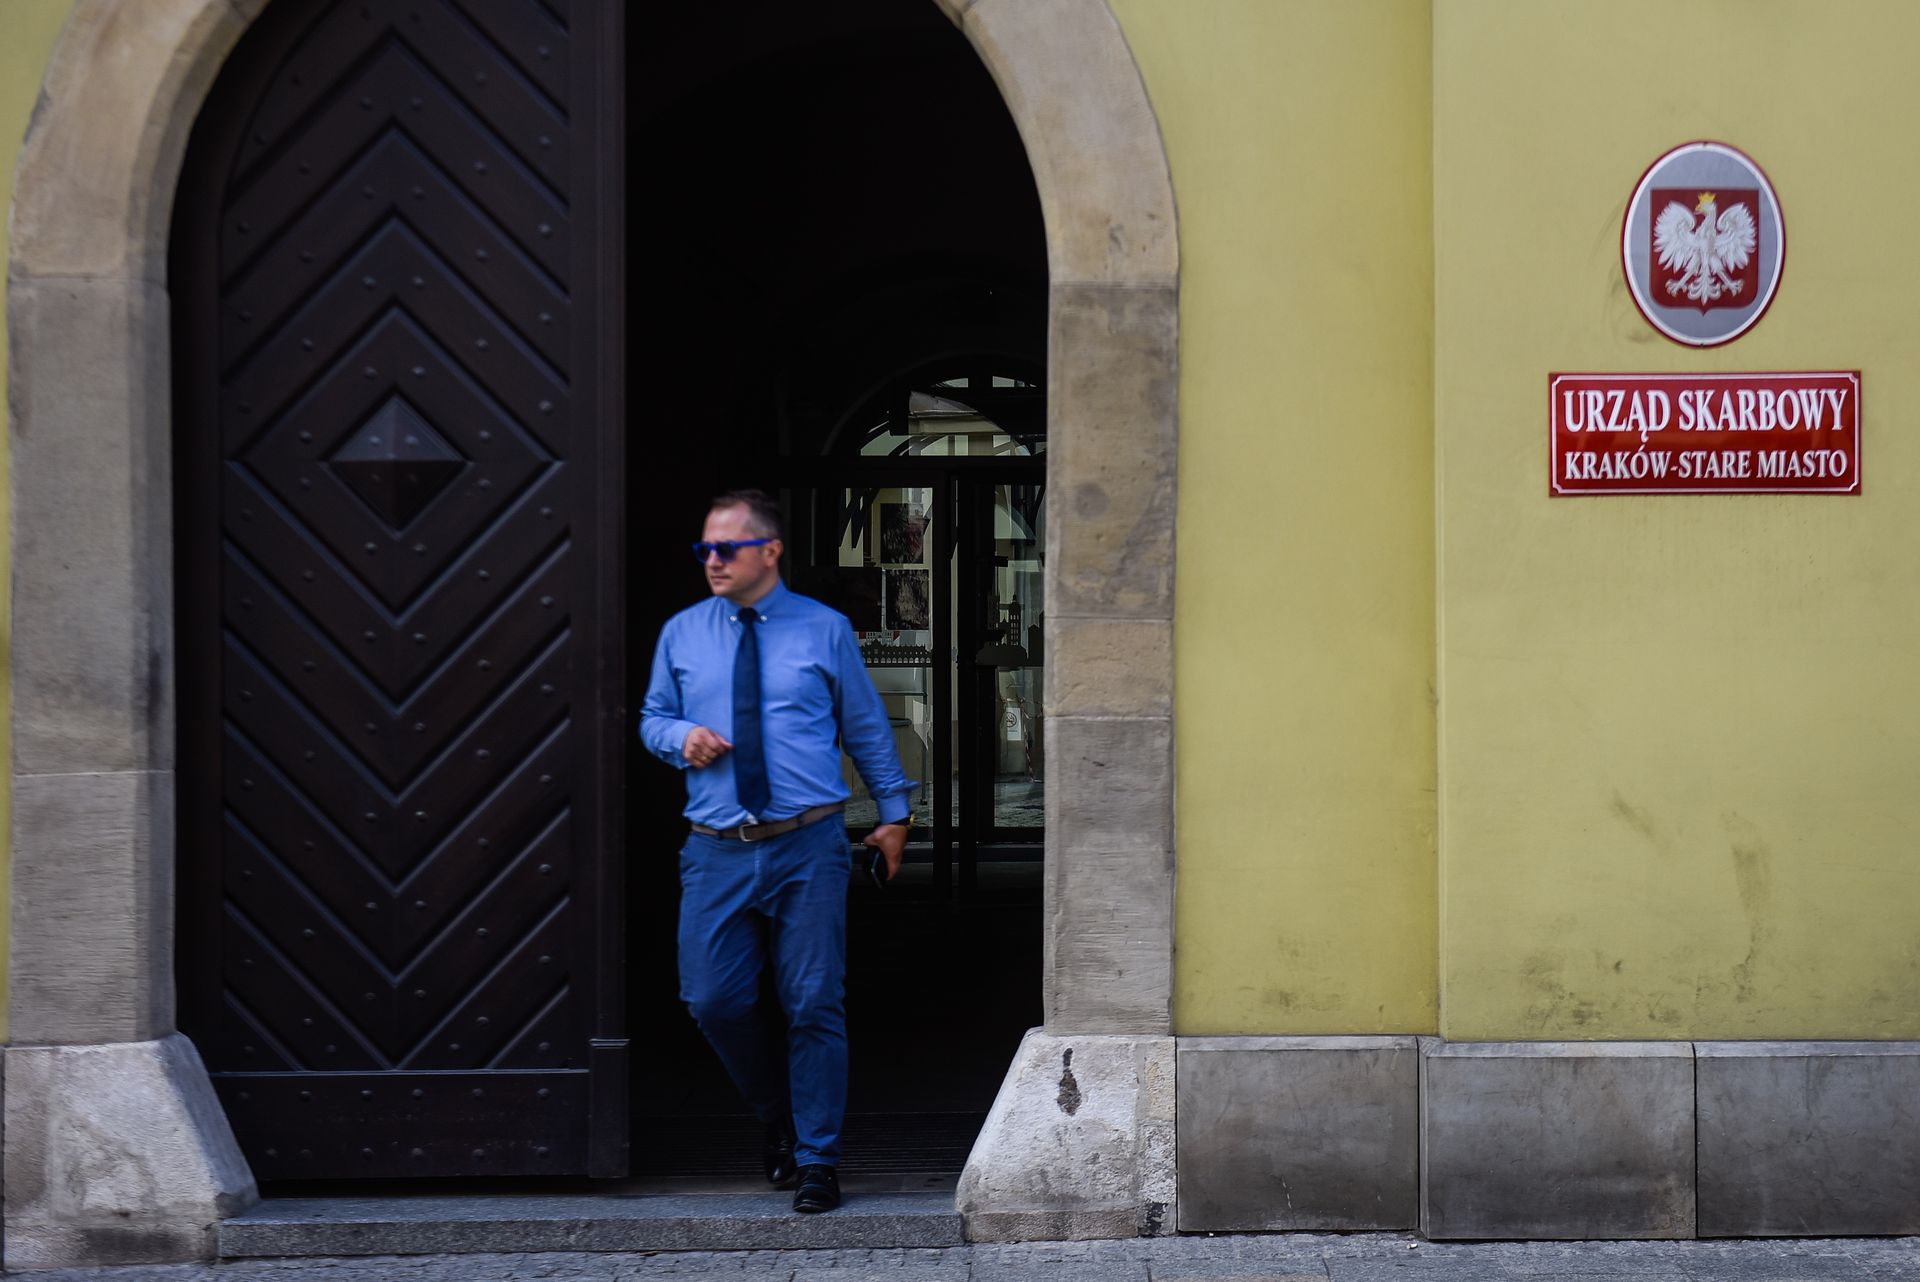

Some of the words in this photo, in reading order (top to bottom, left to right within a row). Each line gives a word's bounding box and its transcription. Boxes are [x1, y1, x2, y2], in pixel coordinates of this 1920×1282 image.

[1563, 389, 1672, 443] URZĄD
[1678, 388, 1848, 432] SKARBOWY
[1564, 445, 1751, 480] KRAKÓW-STARE
[1757, 449, 1848, 479] MIASTO
